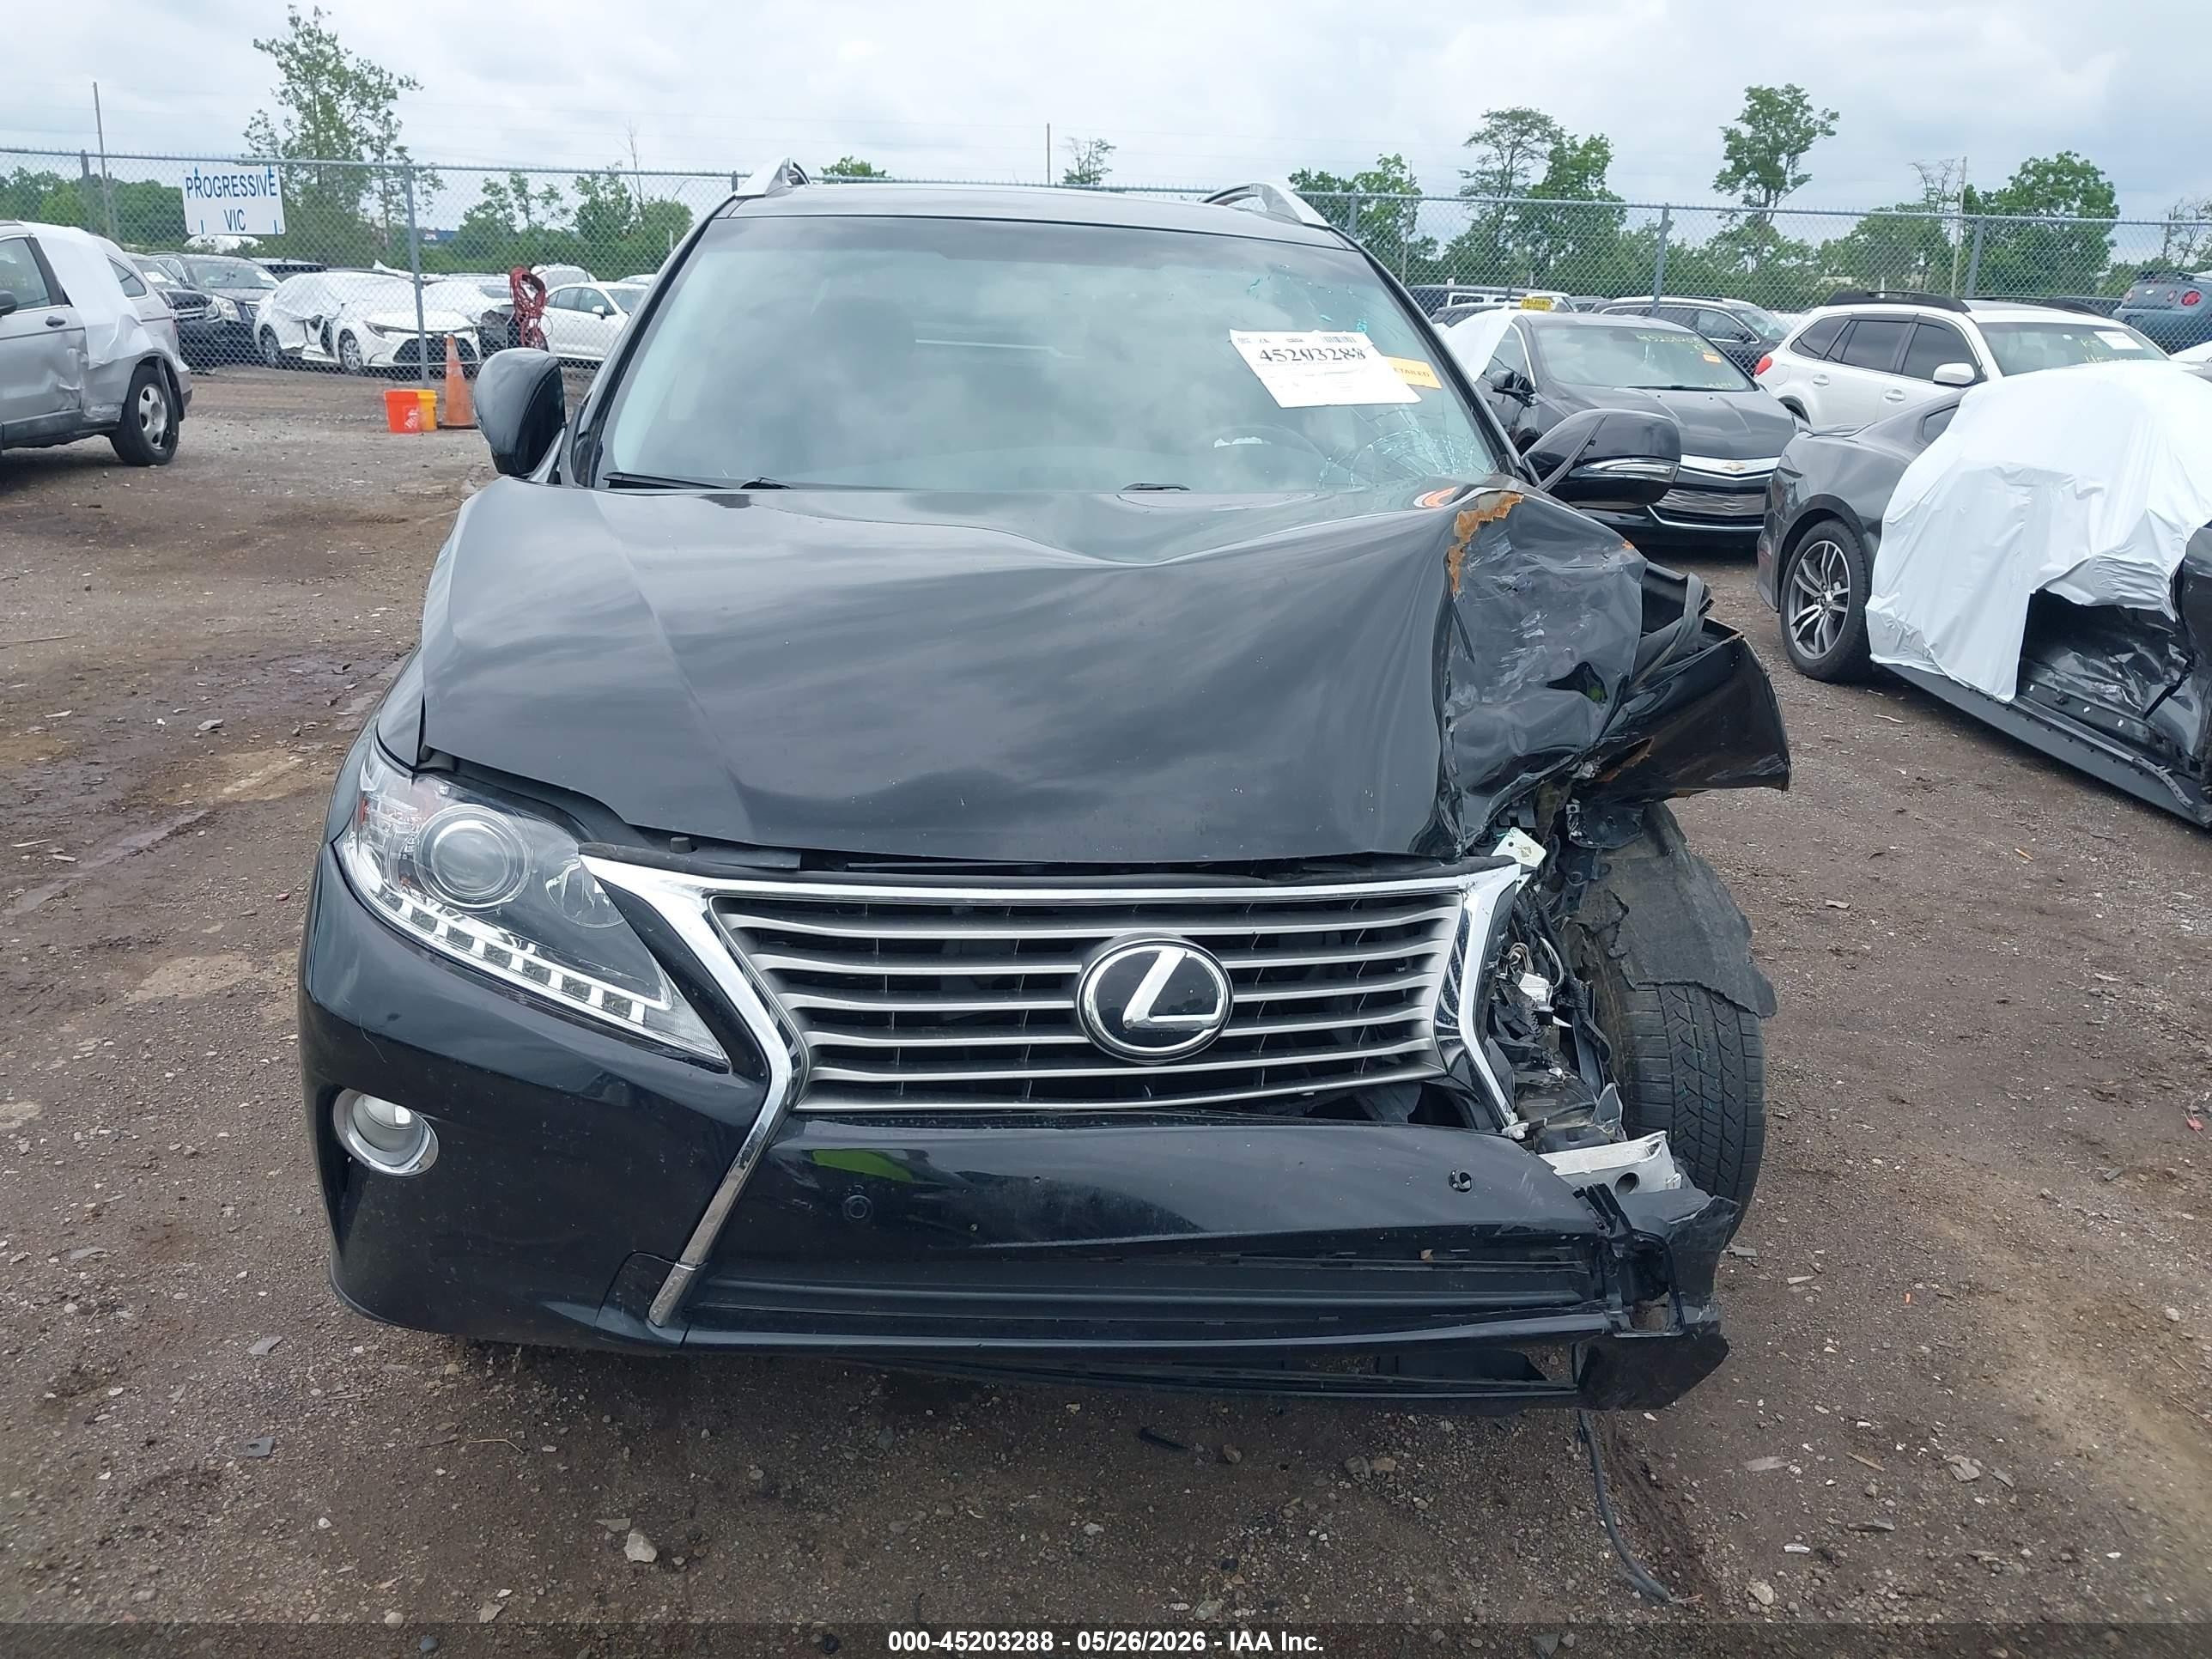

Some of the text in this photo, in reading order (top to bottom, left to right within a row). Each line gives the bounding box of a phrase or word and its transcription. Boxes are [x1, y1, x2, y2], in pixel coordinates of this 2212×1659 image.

[185, 173, 278, 199] PROGRESSIVE
[223, 209, 246, 232] VIC
[1259, 347, 1367, 362] 45203288
